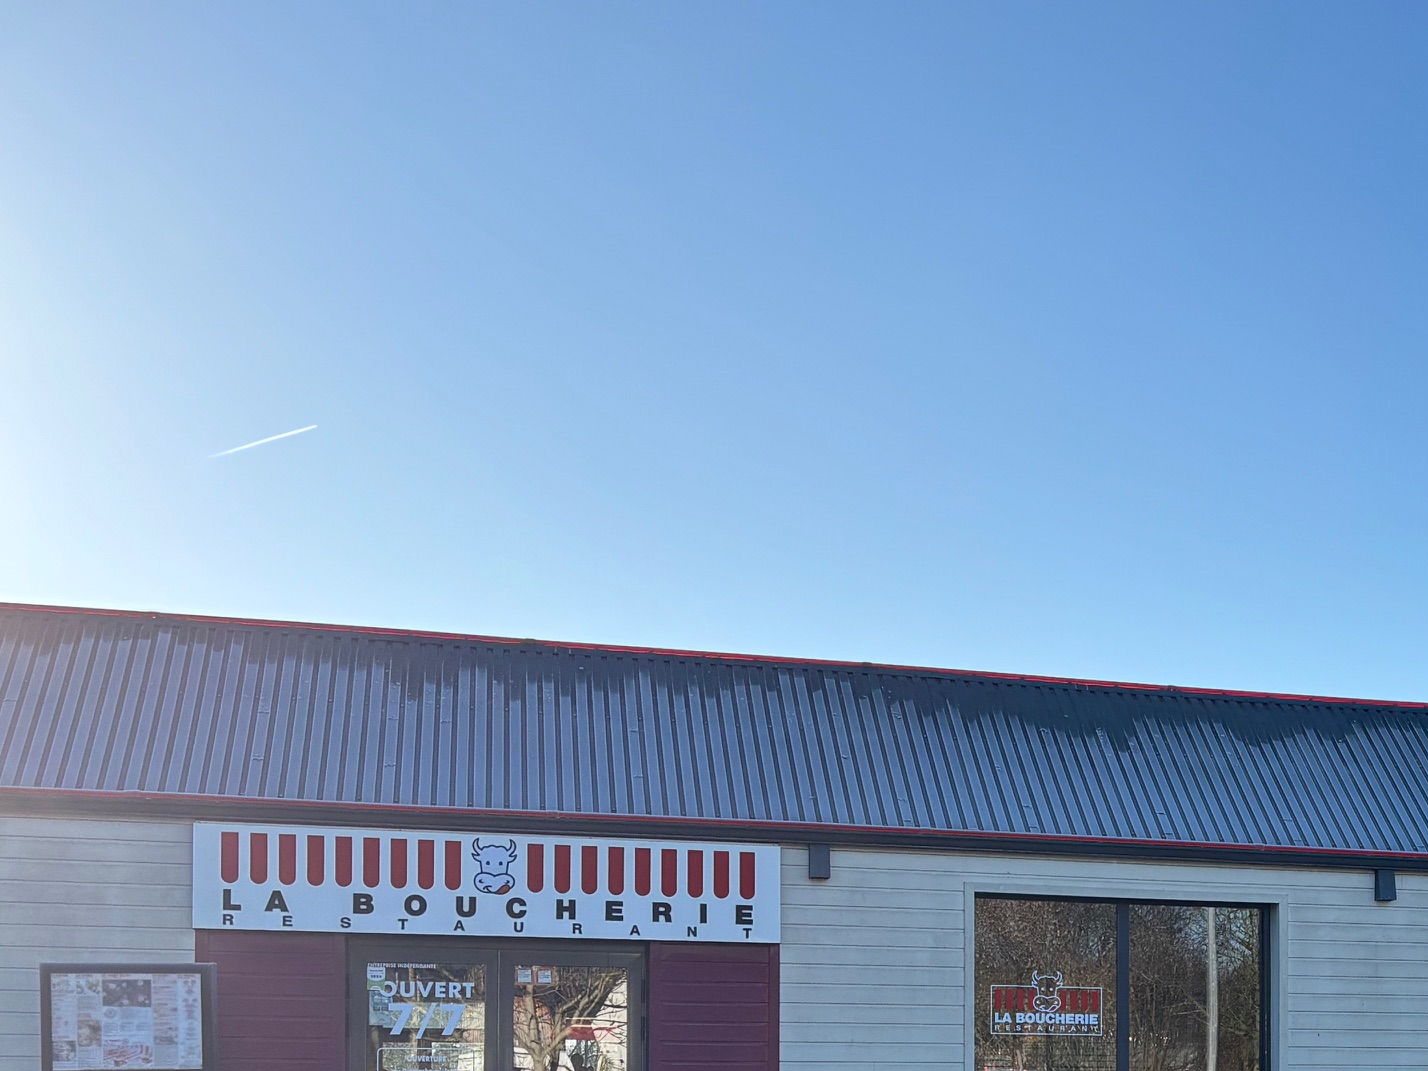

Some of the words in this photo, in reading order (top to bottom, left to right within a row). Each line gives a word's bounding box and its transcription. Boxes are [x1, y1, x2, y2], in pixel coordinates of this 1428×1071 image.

[222, 889, 289, 913] LA
[352, 893, 754, 925] BOUCHERIE
[222, 913, 753, 939] RESTAURANT
[380, 980, 475, 999] OUVERT
[388, 1002, 467, 1040] 7/7
[994, 1012, 1013, 1024] LA
[1015, 1012, 1099, 1026] BOUCHERIE
[994, 1024, 1100, 1033] RESTAURANT
